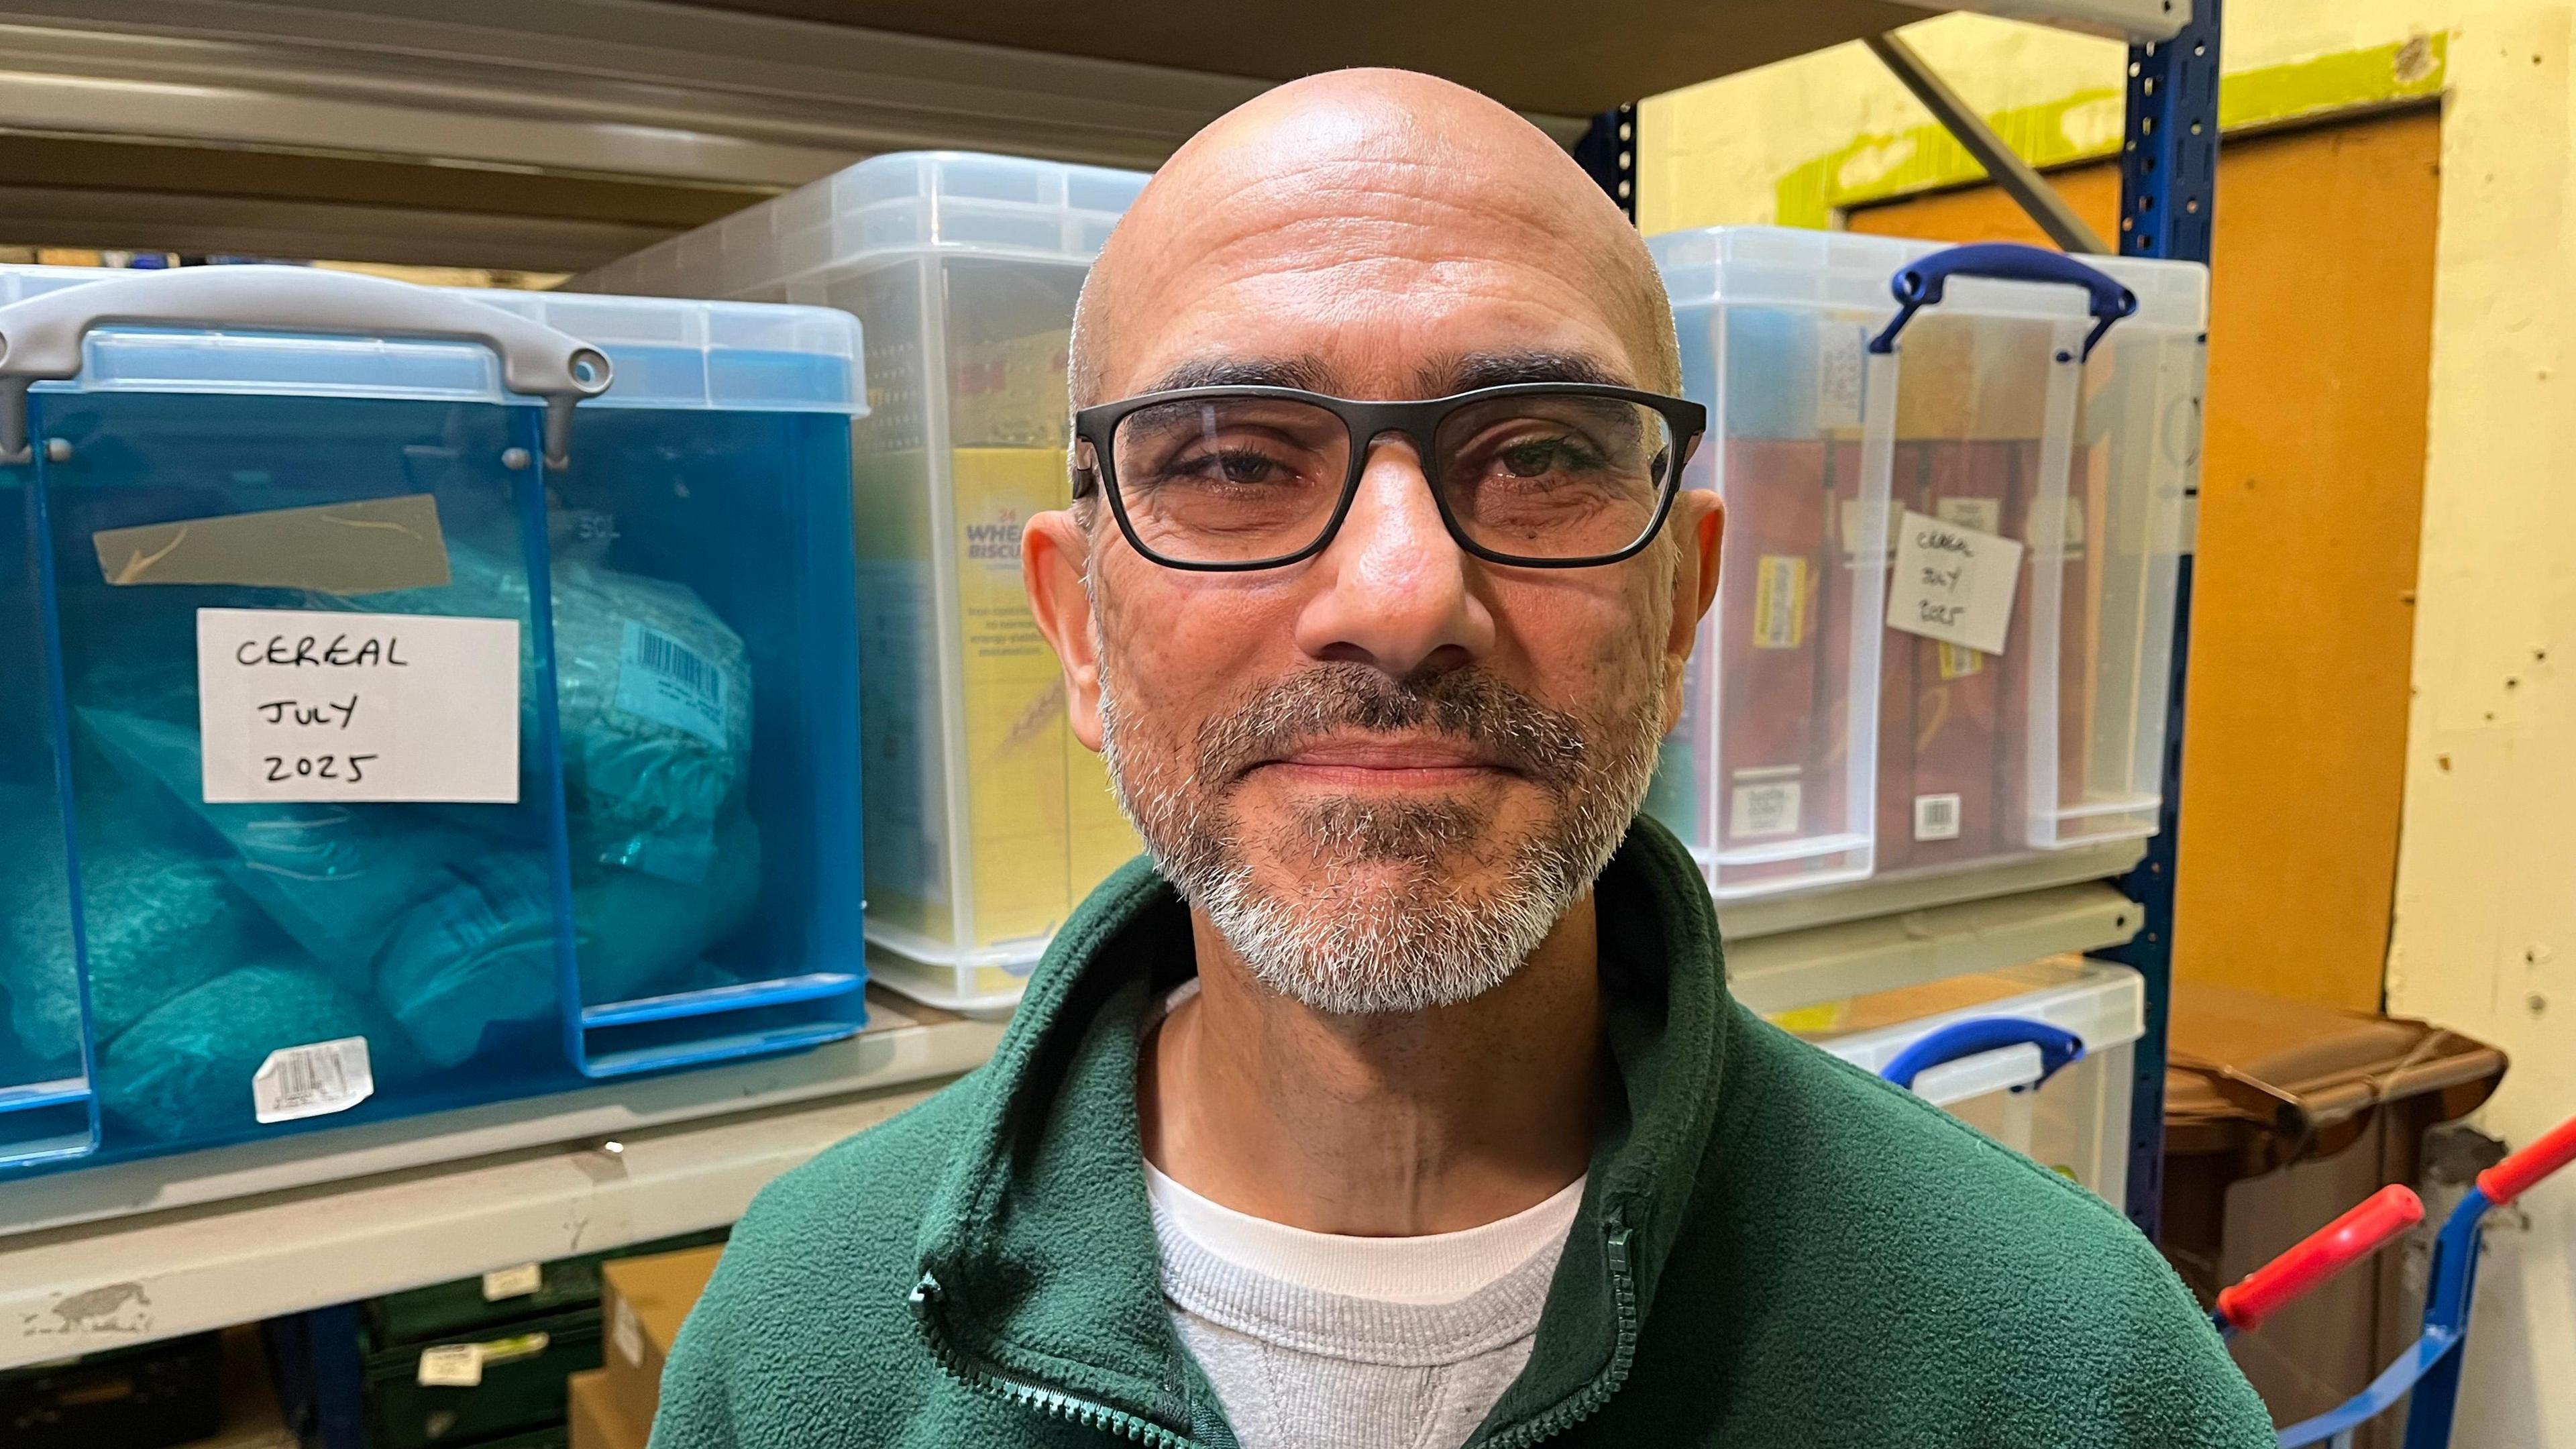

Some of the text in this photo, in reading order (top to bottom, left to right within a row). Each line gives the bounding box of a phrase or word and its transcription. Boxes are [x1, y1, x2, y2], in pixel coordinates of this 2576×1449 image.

[967, 525, 1022, 542] WHE
[969, 544, 1021, 558] BISCU
[237, 634, 408, 666] CEREAL
[257, 692, 358, 729] JULY
[264, 753, 379, 783] 2025
